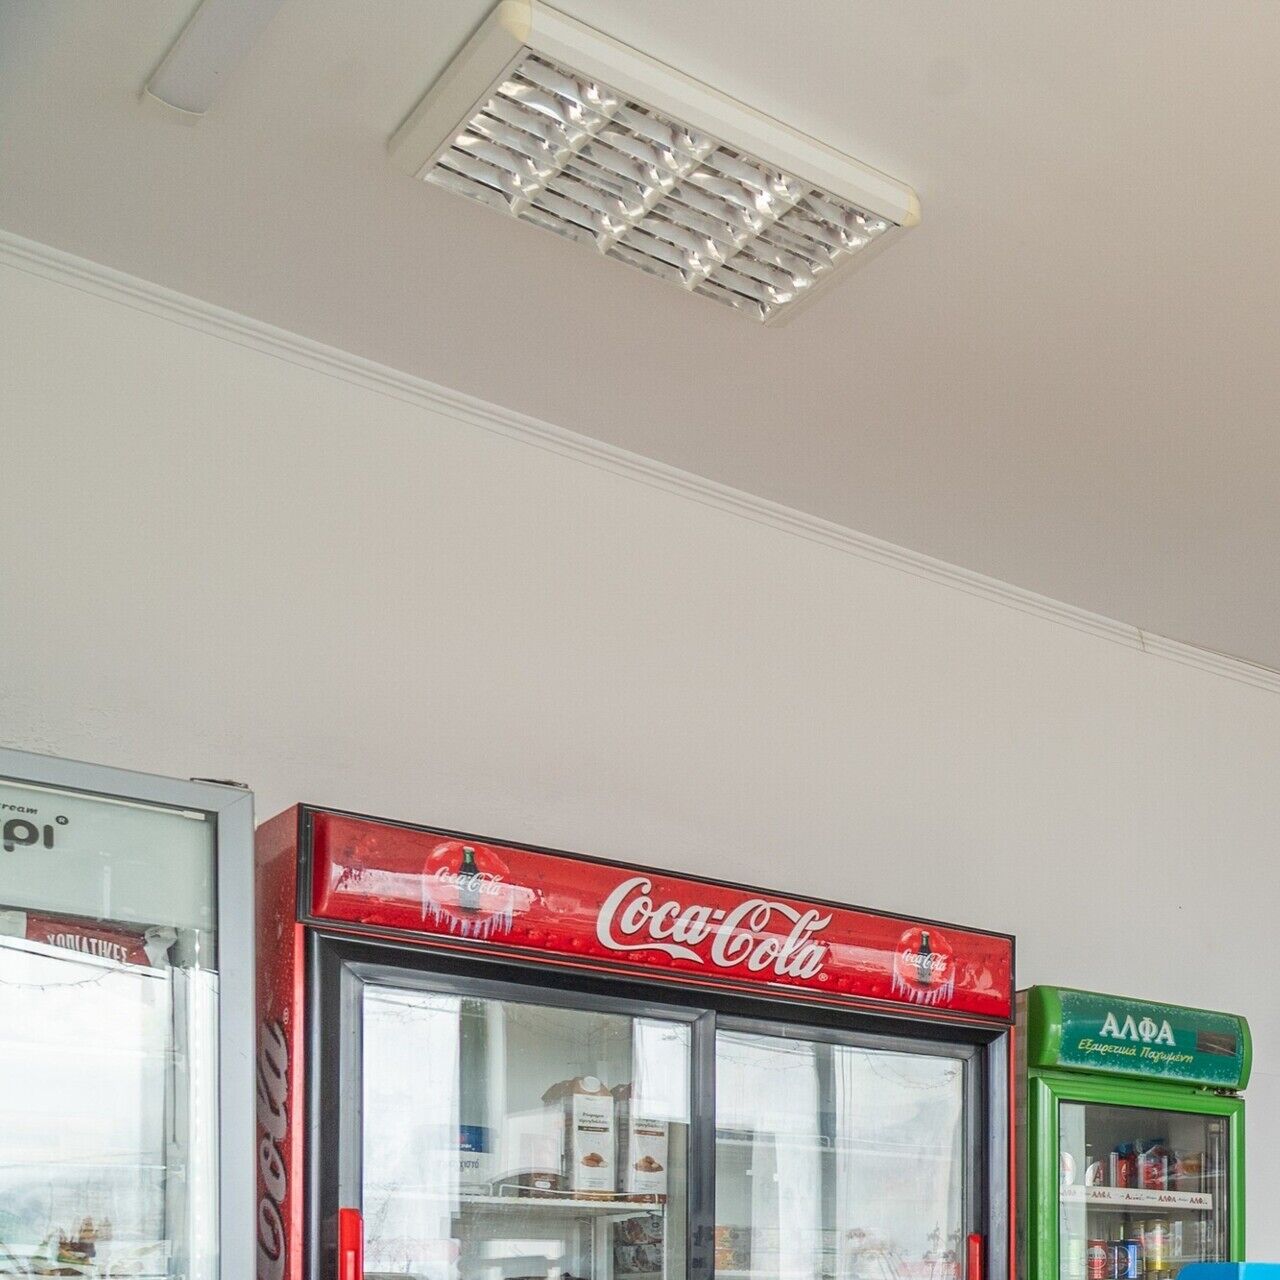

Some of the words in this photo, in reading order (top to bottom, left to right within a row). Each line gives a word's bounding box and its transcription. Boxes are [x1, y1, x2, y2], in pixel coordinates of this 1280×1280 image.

[0, 802, 38, 815] ream
[3, 819, 54, 852] pi
[435, 865, 503, 896] Coca-Cola
[597, 876, 832, 980] Coca-Cola
[901, 946, 948, 972] Coca-Cola
[1099, 1011, 1177, 1047] ΑΛΦΑ
[1078, 1038, 1137, 1057] Εξαιρετικά
[1139, 1046, 1194, 1064] Παγωμένη
